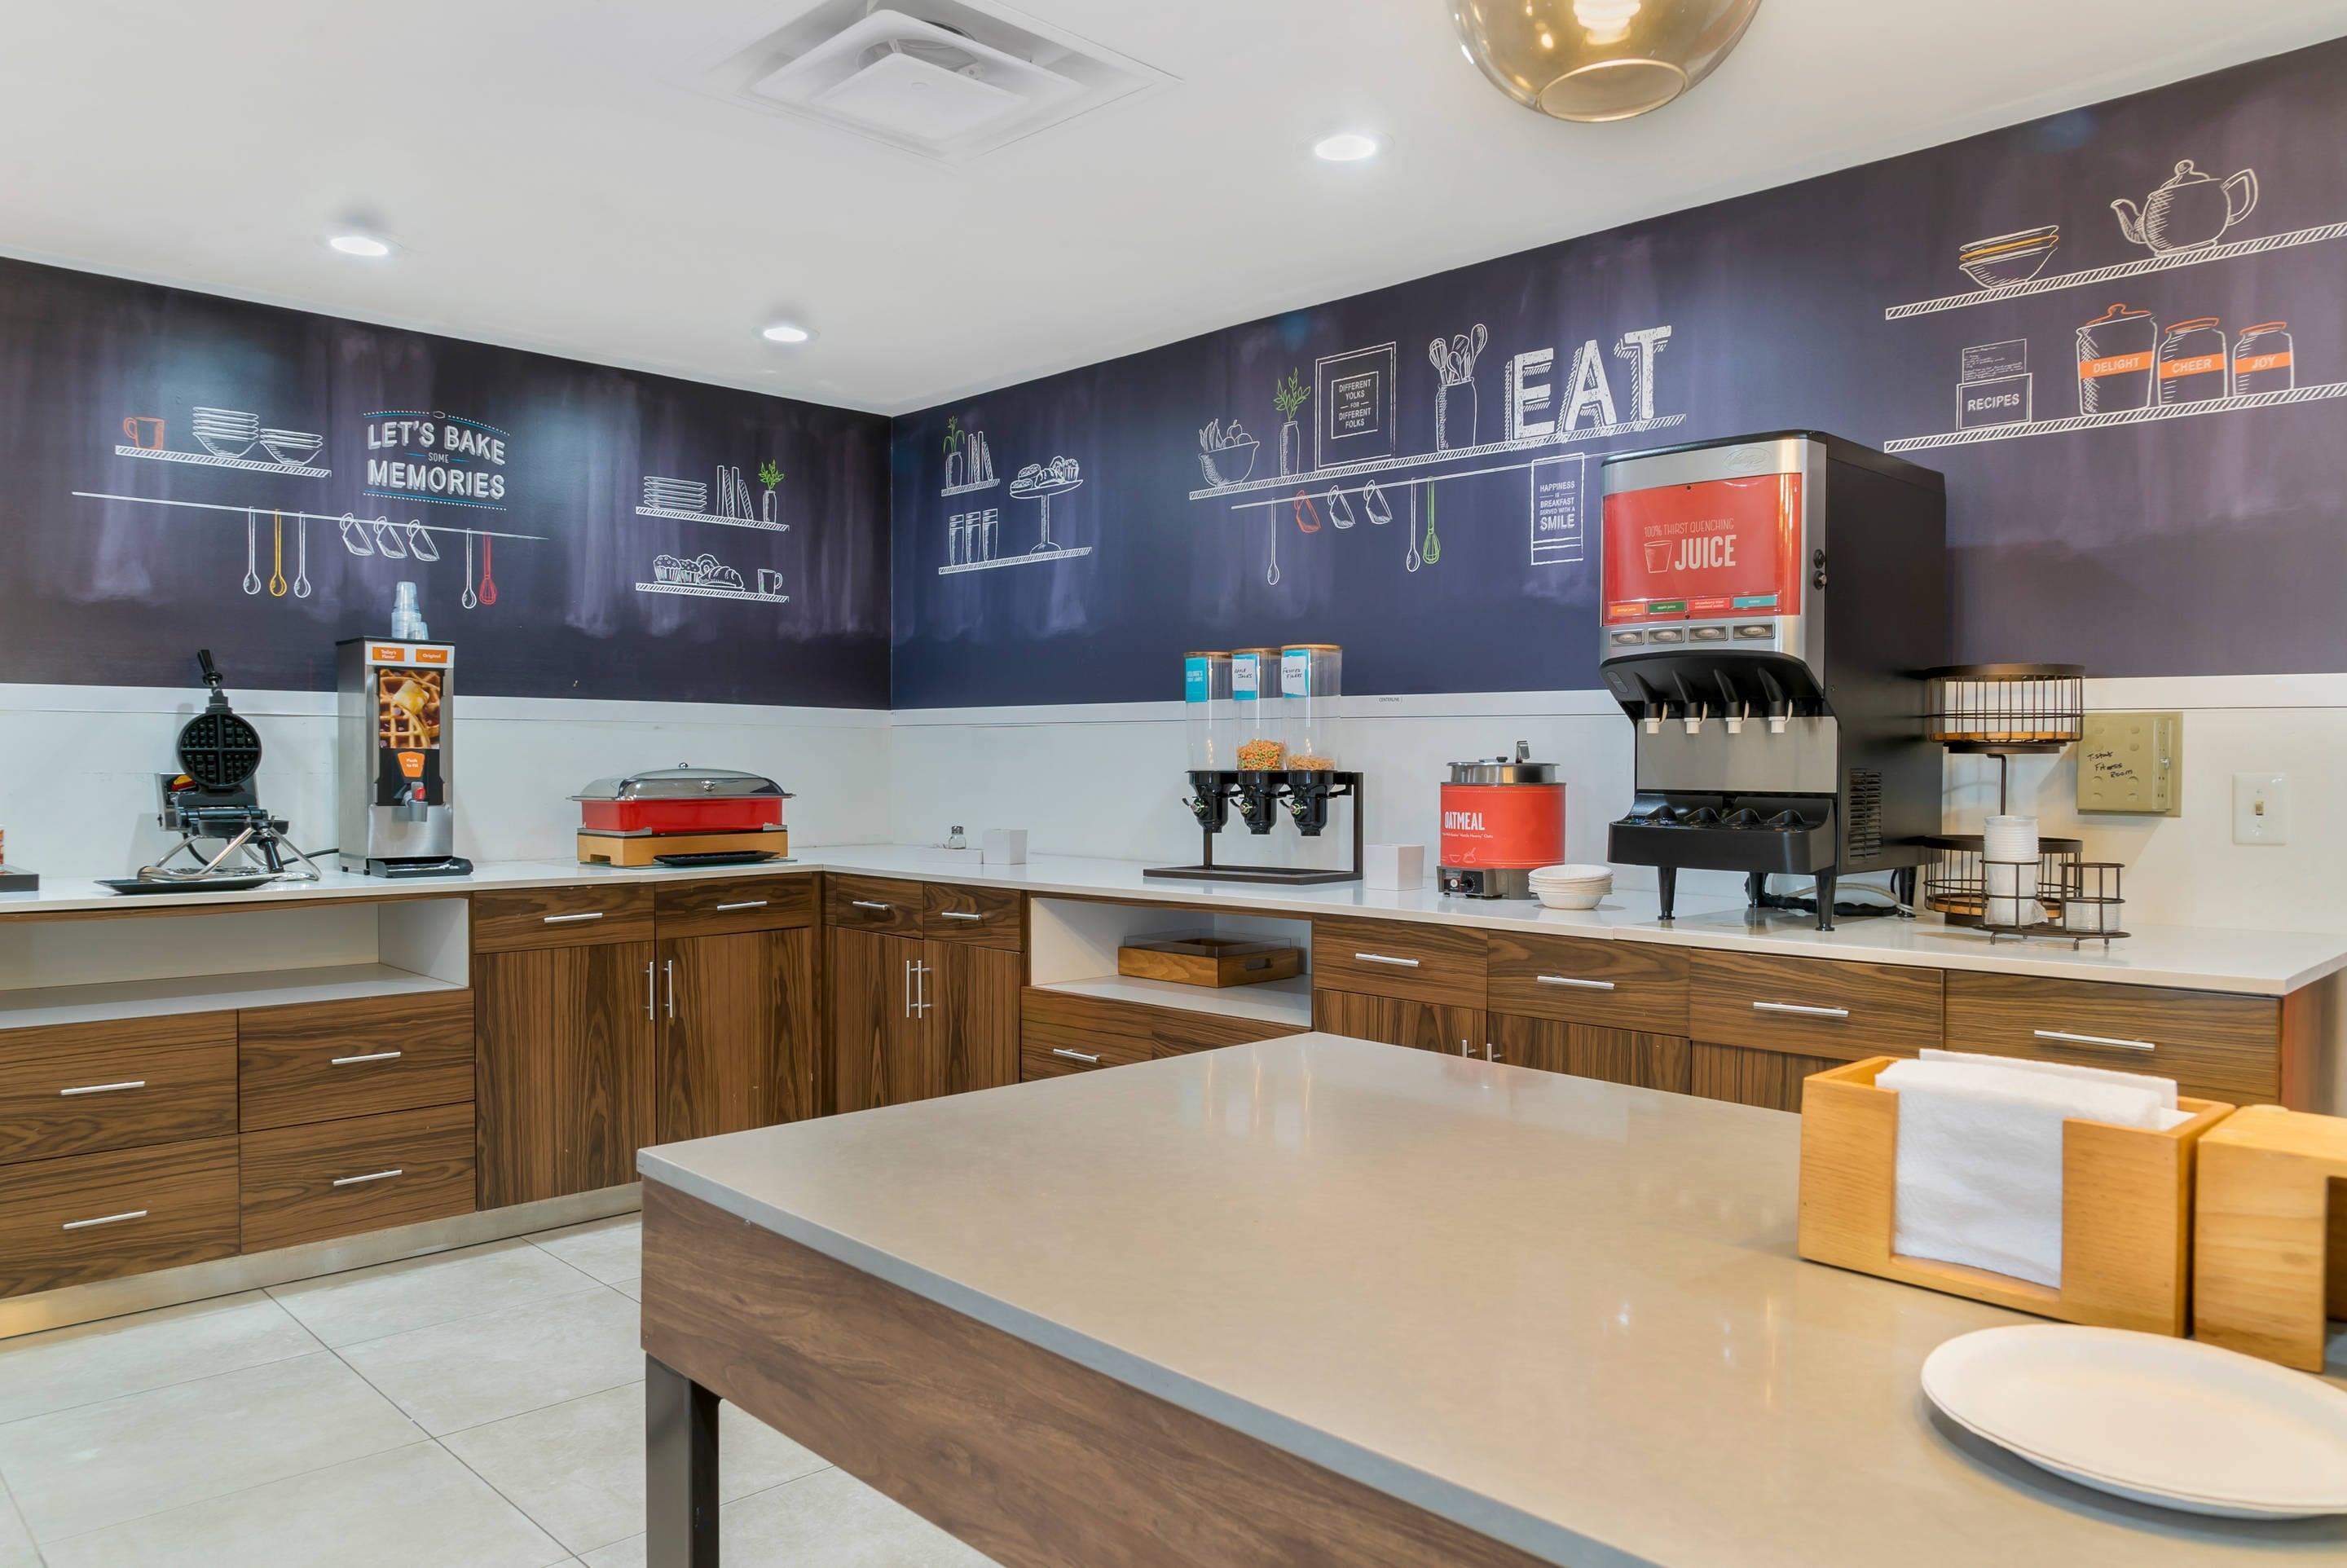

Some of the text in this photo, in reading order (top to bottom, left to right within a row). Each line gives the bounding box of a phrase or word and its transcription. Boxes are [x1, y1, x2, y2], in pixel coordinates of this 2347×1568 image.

[2093, 357, 2140, 374] DELIGHT
[2172, 359, 2213, 374] CHEER
[2252, 356, 2276, 369] JOY
[1339, 379, 1372, 393] DIFFERENT
[1505, 325, 1671, 441] EAT
[1345, 390, 1365, 400] YOLKS
[1967, 393, 2019, 412] RECIPES
[1339, 407, 1371, 421] DIFFERENT
[1345, 418, 1365, 429] FOLKS
[368, 421, 505, 466] LET'S BAKE
[428, 451, 449, 464] SOME
[368, 459, 505, 500] MEMORIES
[1539, 481, 1575, 493] HAPPINESS
[1539, 496, 1575, 509] BREAKFAST
[1539, 508, 1557, 516] SERVED
[1539, 513, 1575, 532] SMILE
[1644, 518, 1734, 537] 100% THIRST QUENCHING
[1675, 534, 1737, 570] JUICE
[1445, 811, 1486, 830] OATMEAL
